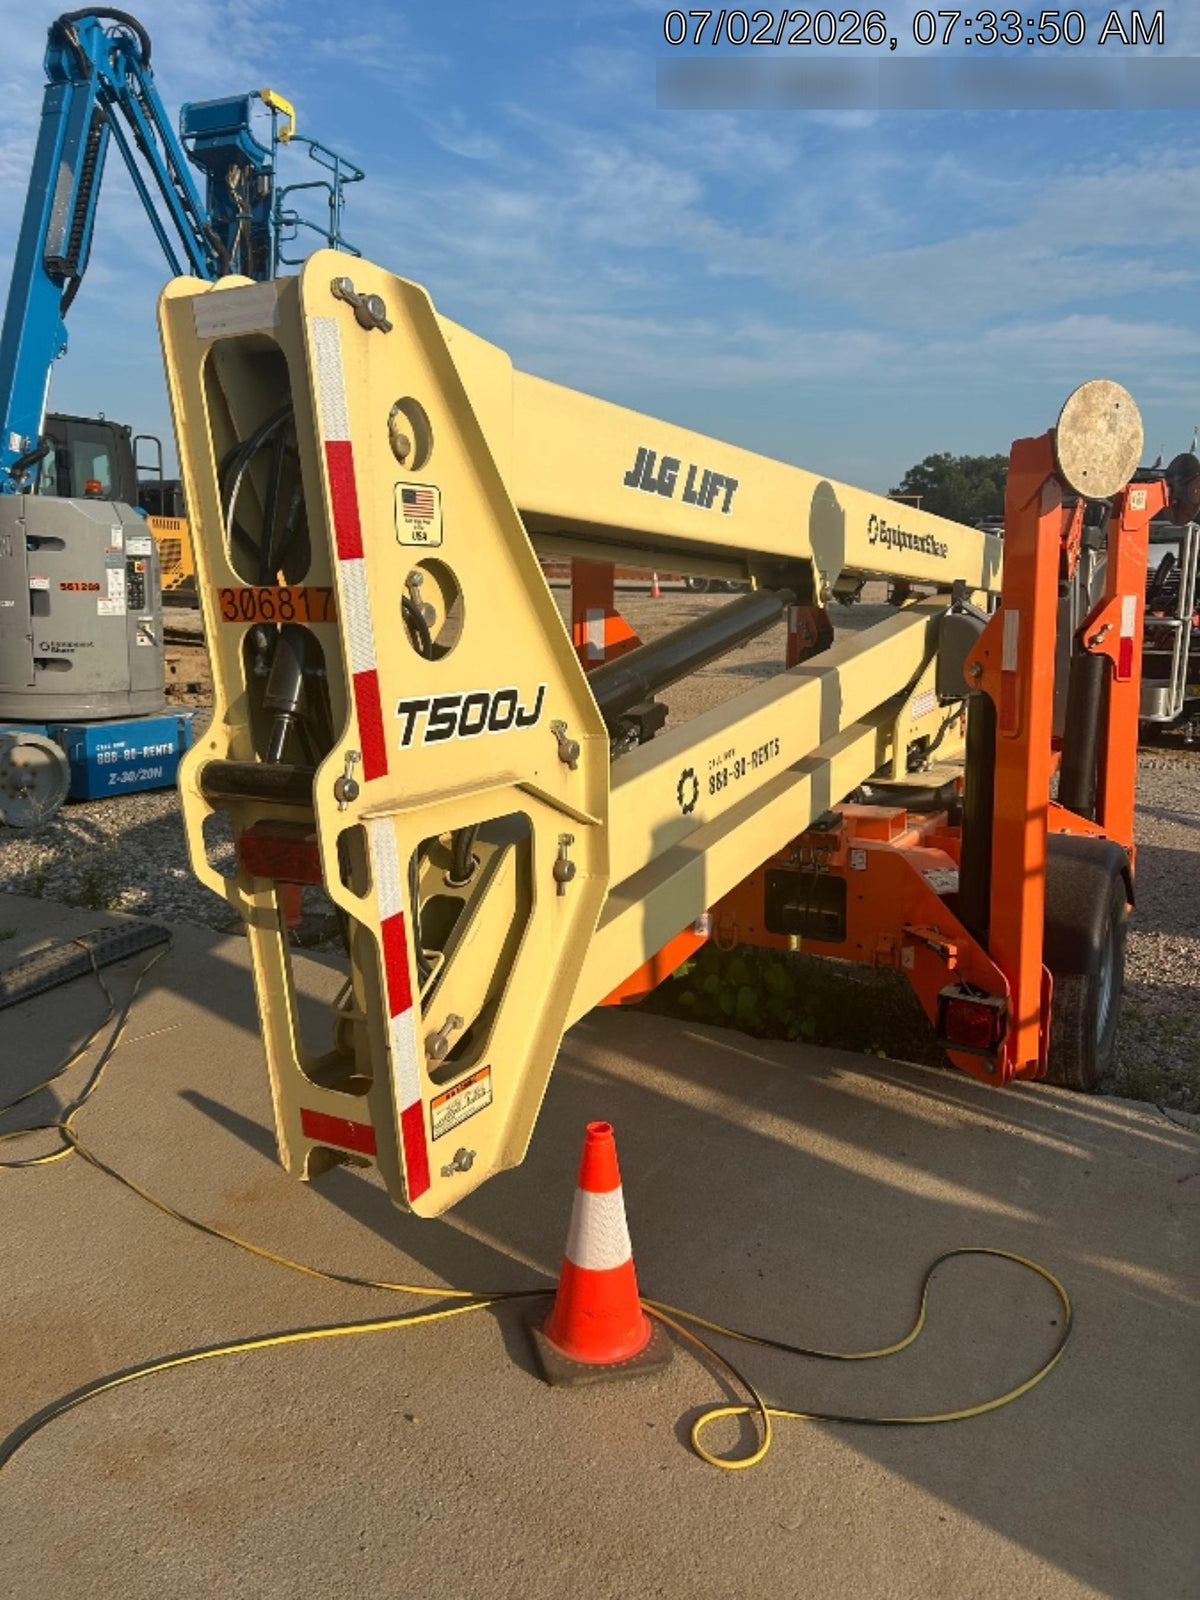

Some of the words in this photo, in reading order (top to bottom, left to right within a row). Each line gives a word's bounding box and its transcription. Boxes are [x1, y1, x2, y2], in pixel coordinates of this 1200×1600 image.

[623, 446, 681, 498] JLG
[682, 463, 738, 514] LIFT
[411, 531, 428, 541] USA
[221, 587, 332, 621] 306817
[397, 684, 546, 748] T500J
